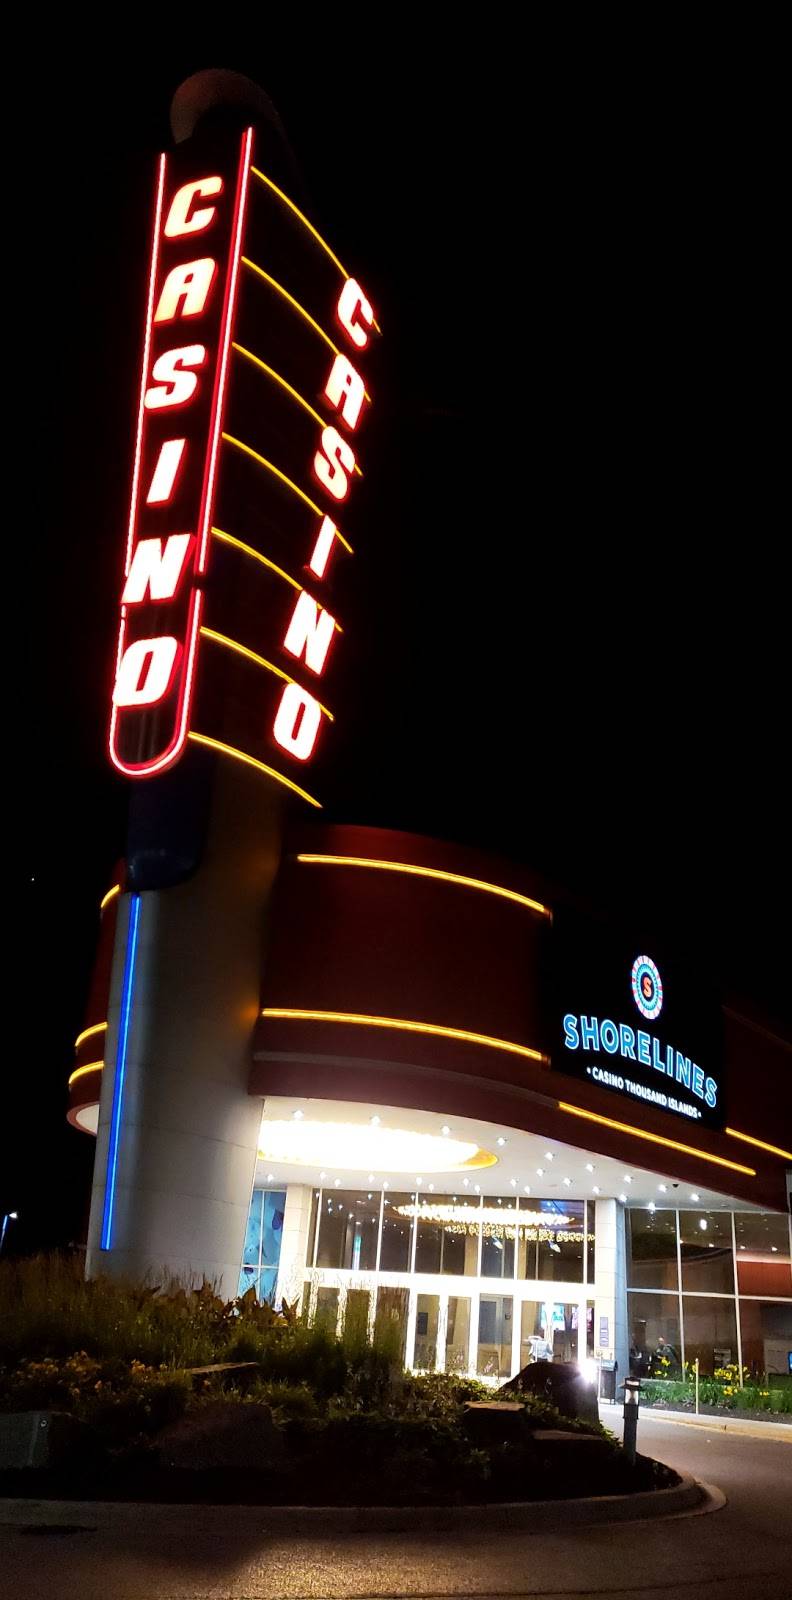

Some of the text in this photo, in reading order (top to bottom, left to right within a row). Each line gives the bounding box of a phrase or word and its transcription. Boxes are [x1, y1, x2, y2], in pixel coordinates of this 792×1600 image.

[111, 175, 223, 708] CASINO
[273, 277, 375, 762] CASINO
[643, 976, 652, 998] S
[563, 1013, 718, 1108] SHORELINES
[592, 1066, 698, 1119] CASINO THOUSAND ISLANDS
